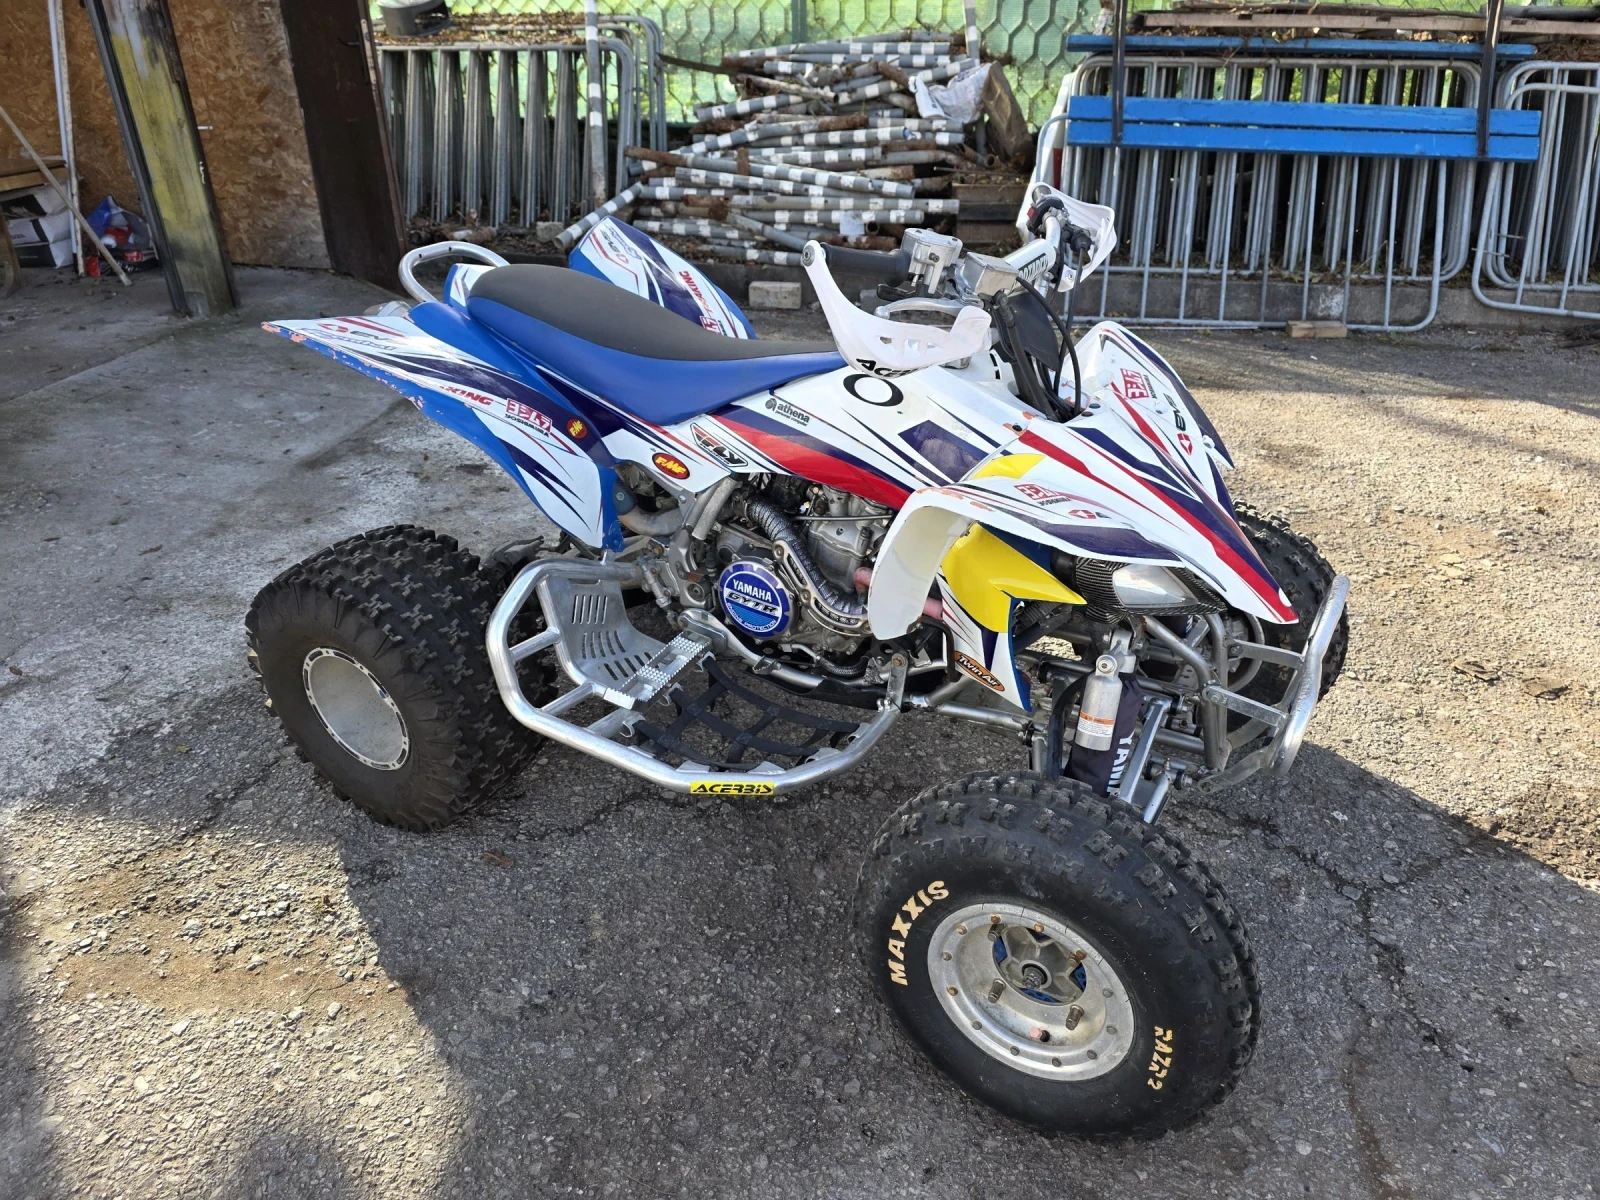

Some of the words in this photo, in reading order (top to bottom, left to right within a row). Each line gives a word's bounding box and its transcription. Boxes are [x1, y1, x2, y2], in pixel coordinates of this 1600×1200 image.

[777, 403, 810, 424] athena
[655, 456, 687, 474] FMF
[733, 579, 772, 602] YAMAHA
[728, 592, 778, 615] GYTR
[744, 619, 777, 631] PROTECTION
[959, 655, 983, 677] Twin
[982, 674, 999, 686] Air
[693, 784, 772, 794] ACERBIS
[888, 880, 950, 986] MAXXIS
[1147, 1026, 1173, 1090] RAZR2
